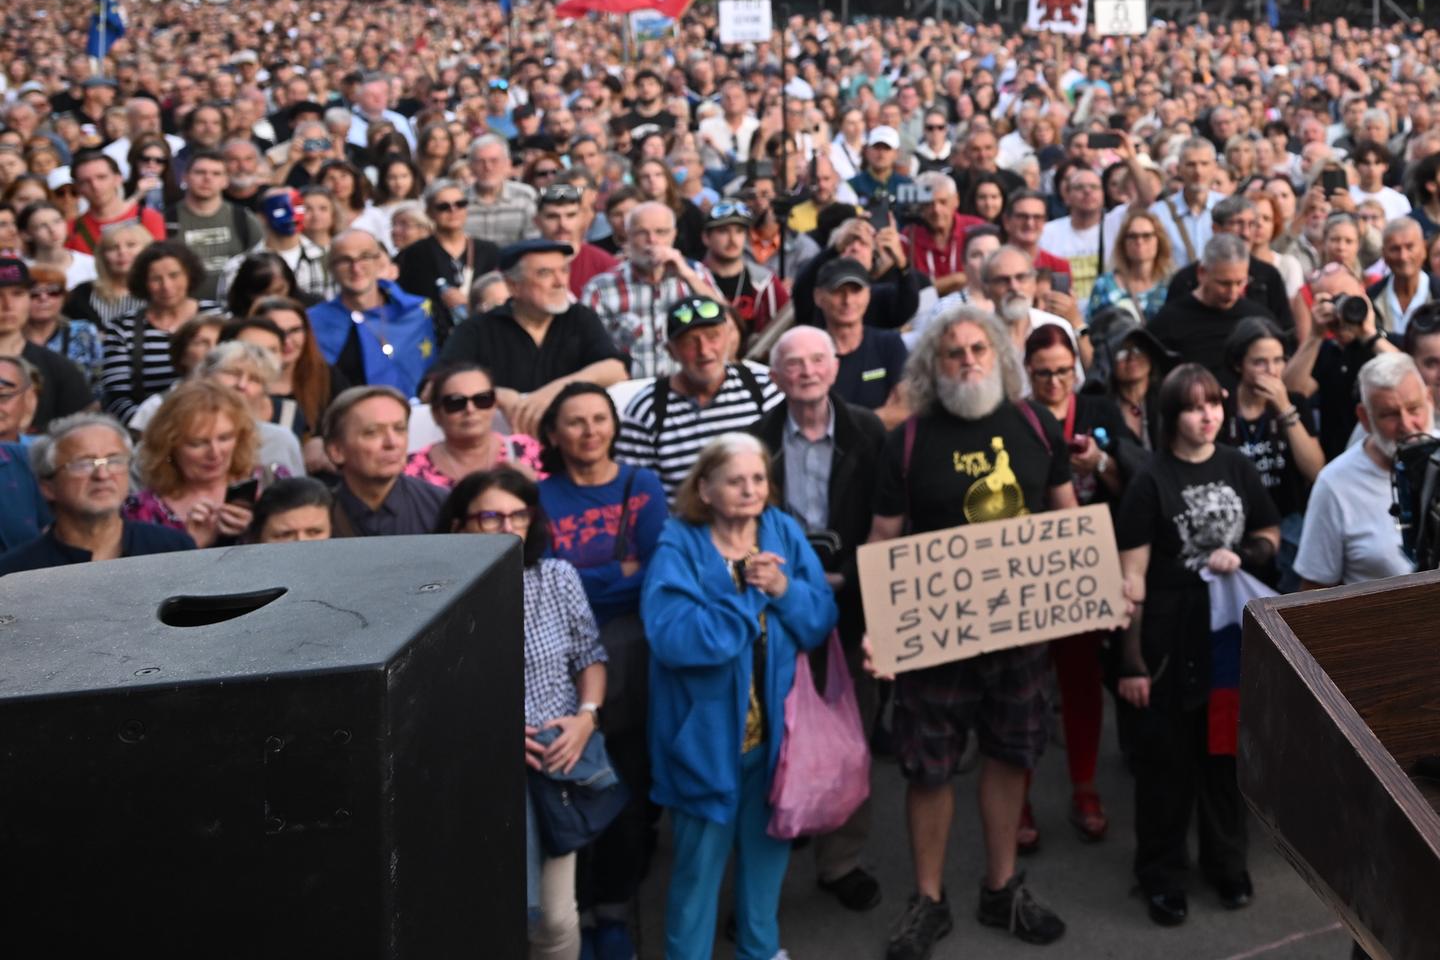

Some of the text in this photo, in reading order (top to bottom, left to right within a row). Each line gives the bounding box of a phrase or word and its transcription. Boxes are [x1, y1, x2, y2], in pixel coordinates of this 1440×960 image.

[889, 535, 969, 571] FICO
[1001, 515, 1096, 548] LÚZER
[889, 568, 973, 606] FICO
[1008, 546, 1100, 579] RUSKO
[896, 599, 977, 633] SVK
[1020, 575, 1097, 606] FICO
[896, 625, 980, 663] SVK
[1019, 598, 1114, 632] EURÓPA
